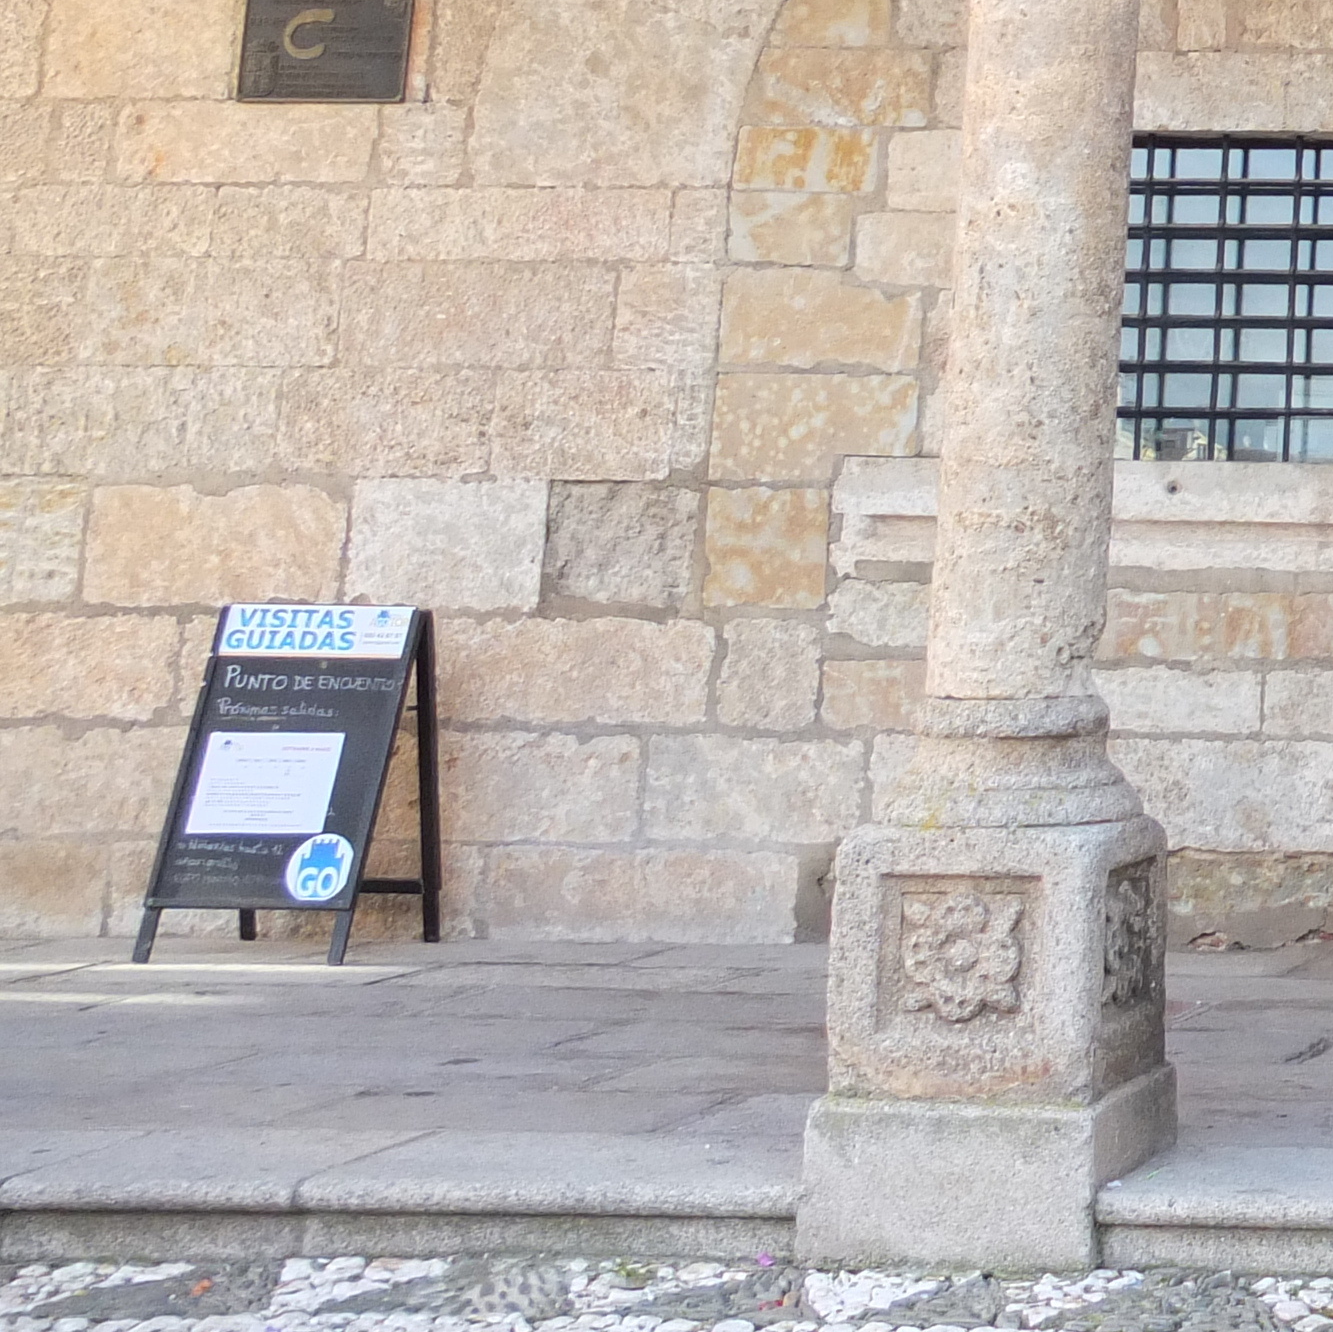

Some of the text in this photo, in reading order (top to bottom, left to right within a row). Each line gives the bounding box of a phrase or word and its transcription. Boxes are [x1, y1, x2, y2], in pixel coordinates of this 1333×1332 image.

[240, 608, 355, 629] VISITAS
[226, 629, 356, 650] GUIADAS
[293, 675, 314, 690] DE
[296, 867, 340, 898] GO
